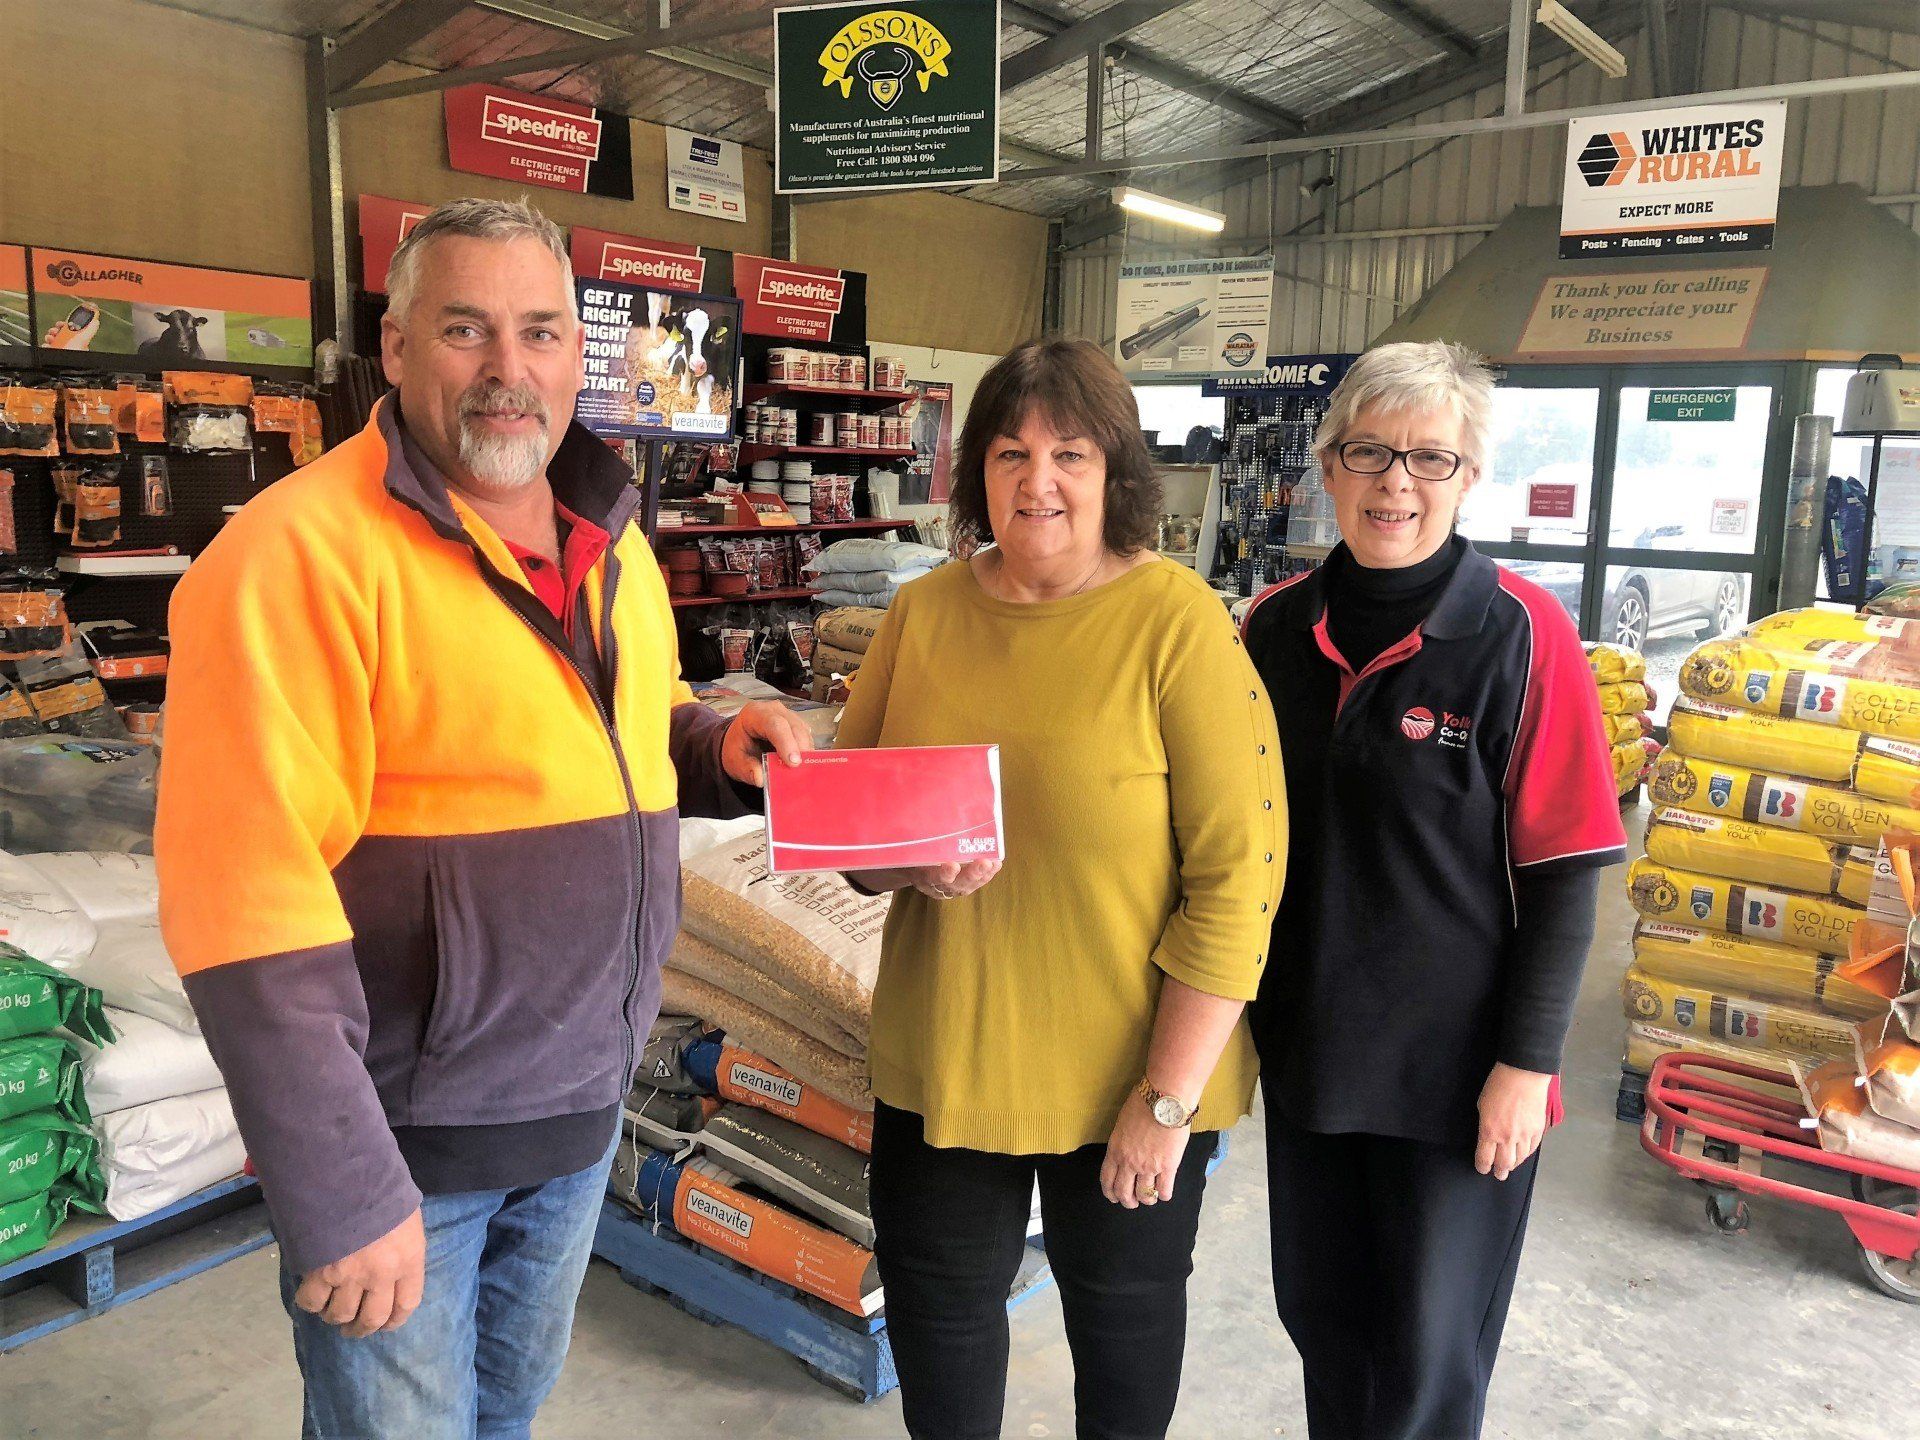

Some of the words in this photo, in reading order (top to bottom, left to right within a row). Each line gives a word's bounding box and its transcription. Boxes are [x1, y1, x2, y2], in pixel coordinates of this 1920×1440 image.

[831, 17, 941, 63] OLSSON'S
[496, 111, 588, 144] speedrite
[790, 121, 852, 133] Manufacturers
[854, 119, 863, 128] of
[864, 115, 910, 128] Australia's
[912, 114, 936, 124] finest
[938, 110, 985, 122] nutritional
[803, 132, 855, 145] supplements
[857, 130, 870, 140] for
[871, 127, 921, 140] maximizing
[923, 124, 970, 137] production
[1642, 119, 1765, 156] WHITES
[826, 145, 873, 158] Nutritional
[874, 143, 913, 156] Advisory
[915, 141, 947, 151] Service
[510, 157, 552, 172] ELECTRIC
[553, 165, 581, 178] FENCE
[837, 158, 856, 168] Free
[858, 157, 878, 167] Call:
[881, 155, 900, 165] 1800
[902, 154, 918, 164] 804
[920, 153, 936, 163] 096
[1638, 148, 1761, 184] RURAL
[526, 169, 567, 184] SYSTEMS
[813, 173, 834, 183] provide
[835, 172, 844, 180] the
[866, 170, 879, 179] with
[880, 170, 889, 178] the
[891, 169, 905, 178] tools
[905, 169, 914, 178] for
[915, 168, 930, 177] good
[931, 166, 956, 175] livestock
[1619, 204, 1671, 218] EXPECT
[1675, 201, 1714, 215] MORE
[1582, 239, 1608, 250] Posts
[1622, 237, 1662, 249] Fencing
[1676, 234, 1705, 245] Gates
[1719, 232, 1749, 242] Tools
[62, 266, 144, 286] GALLAGHER
[612, 257, 695, 282] speedrite
[1122, 267, 1133, 277] DO
[1135, 267, 1142, 276] IT
[1167, 265, 1178, 274] DO
[1179, 265, 1186, 274] IT
[769, 280, 835, 300] speedrite
[1554, 283, 1610, 298] Thank
[1614, 284, 1647, 299] you
[1651, 279, 1680, 295] for
[1684, 277, 1751, 296] calling
[584, 289, 614, 306] GET
[618, 293, 633, 309] IT
[583, 306, 633, 328] RIGHT,
[1550, 305, 1579, 319] We
[1583, 302, 1685, 321] appreciate
[1689, 302, 1738, 318] your
[777, 316, 807, 327] ELECTRIC
[807, 320, 827, 329] FENCE
[788, 327, 817, 336] SYSTEMS
[585, 324, 630, 342] RIGHT
[1585, 328, 1673, 344] Business
[583, 341, 625, 359] FROM
[583, 358, 610, 374] THE
[583, 375, 630, 393] START.
[1654, 393, 1732, 404] EMERGENCY
[1677, 408, 1704, 418] EXIT
[675, 417, 724, 429] veanavite
[846, 625, 863, 636] RAW
[1749, 719, 1774, 728] YOLK
[1751, 711, 1792, 723] GOLDEN
[1852, 706, 1902, 727] YOLK
[1814, 799, 1891, 826] GOLDEN
[1728, 823, 1767, 836] GOLDEN
[1812, 812, 1857, 834] YOLK
[1727, 830, 1751, 841] YOLK
[958, 844, 996, 854] CHOICE
[796, 875, 818, 893] Canola
[807, 881, 832, 898] Linseed
[841, 908, 860, 919] Plain
[858, 899, 882, 911] Canary
[853, 911, 886, 928] Panorama
[1712, 934, 1751, 945] GOLDEN
[1793, 924, 1841, 943] YOLK
[1711, 941, 1736, 951] YOLK
[15, 994, 31, 1008] kg
[1777, 1034, 1819, 1051] YOLK
[9, 1080, 26, 1094] kg
[734, 1068, 796, 1101] veanavite
[9, 1160, 23, 1174] 20
[24, 1152, 39, 1168] kg
[691, 1195, 748, 1232] veanavite
[702, 1220, 721, 1237] CALF
[720, 1230, 749, 1252] PELLETS
